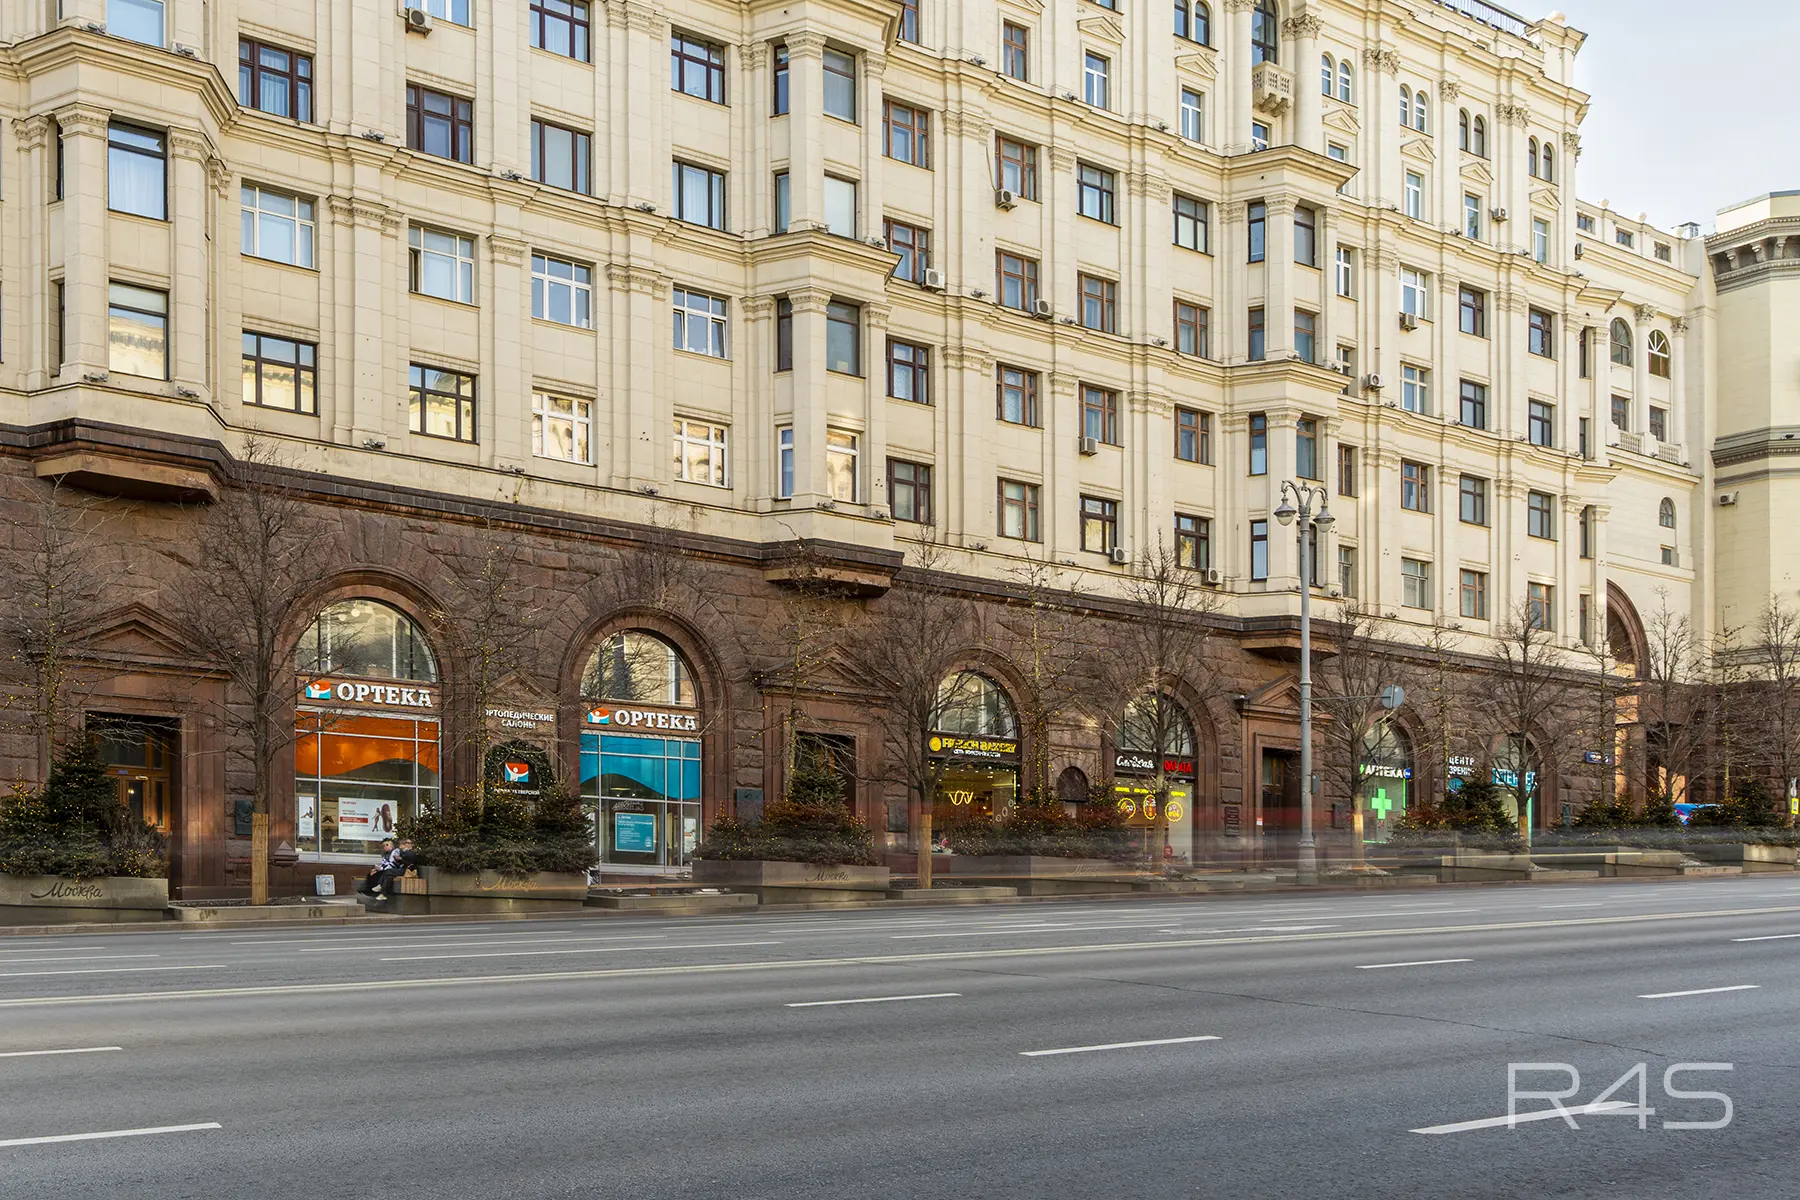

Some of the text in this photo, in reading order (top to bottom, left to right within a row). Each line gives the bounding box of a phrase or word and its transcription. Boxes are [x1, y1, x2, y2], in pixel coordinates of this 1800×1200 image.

[337, 682, 433, 708] ОРТЕКА
[485, 708, 554, 722] ОРТОПЕДИЧЕСКИЕ
[614, 709, 697, 731] ОРТЕКА
[501, 719, 536, 729] САЛОНЫ
[1448, 756, 1475, 766] ЦЕНТР
[1365, 764, 1404, 778] АПТЕКА
[1448, 765, 1475, 777] ЗРЕНИ
[30, 882, 103, 900] Москва
